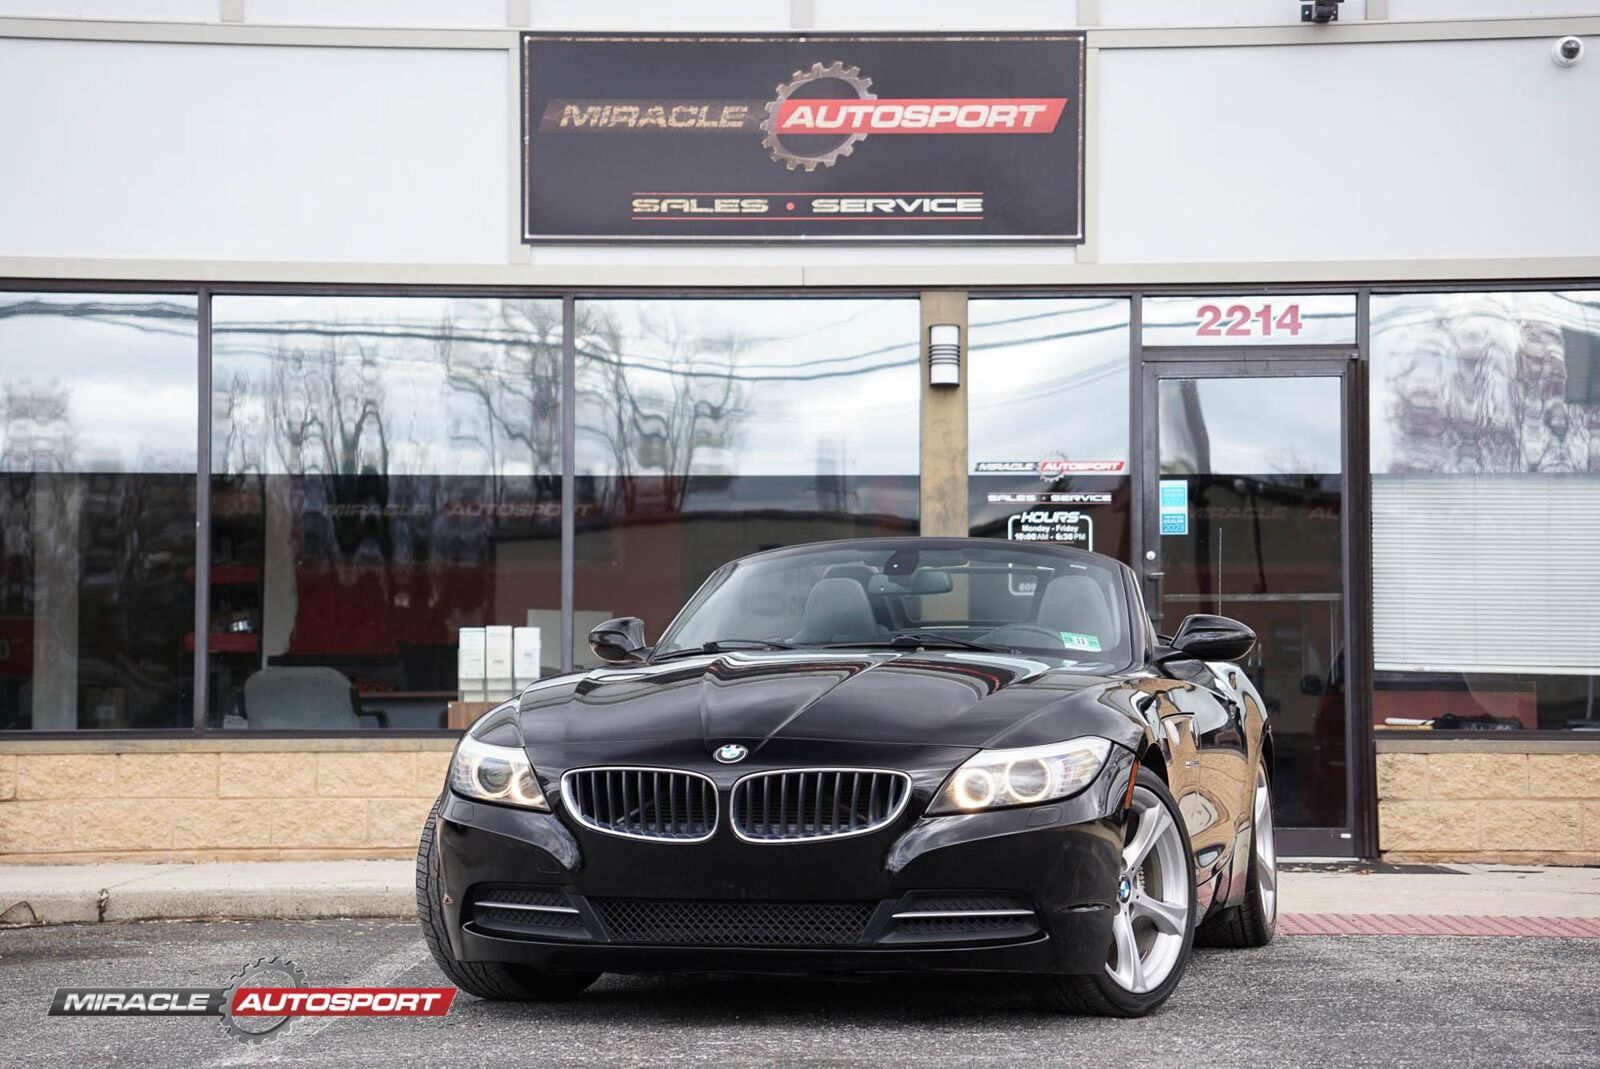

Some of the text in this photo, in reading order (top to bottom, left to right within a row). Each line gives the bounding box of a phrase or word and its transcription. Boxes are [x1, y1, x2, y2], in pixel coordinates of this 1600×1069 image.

[560, 104, 1046, 129] MIRACLE AUTOSPORT
[632, 199, 984, 214] SALES SERVICE
[1196, 304, 1303, 336] 2214
[979, 462, 1118, 471] MIRACLE AUTOSPORT
[988, 494, 1112, 502] SALES SERVICE
[1021, 511, 1080, 523] HOURS
[1022, 525, 1079, 533] Monday Friday
